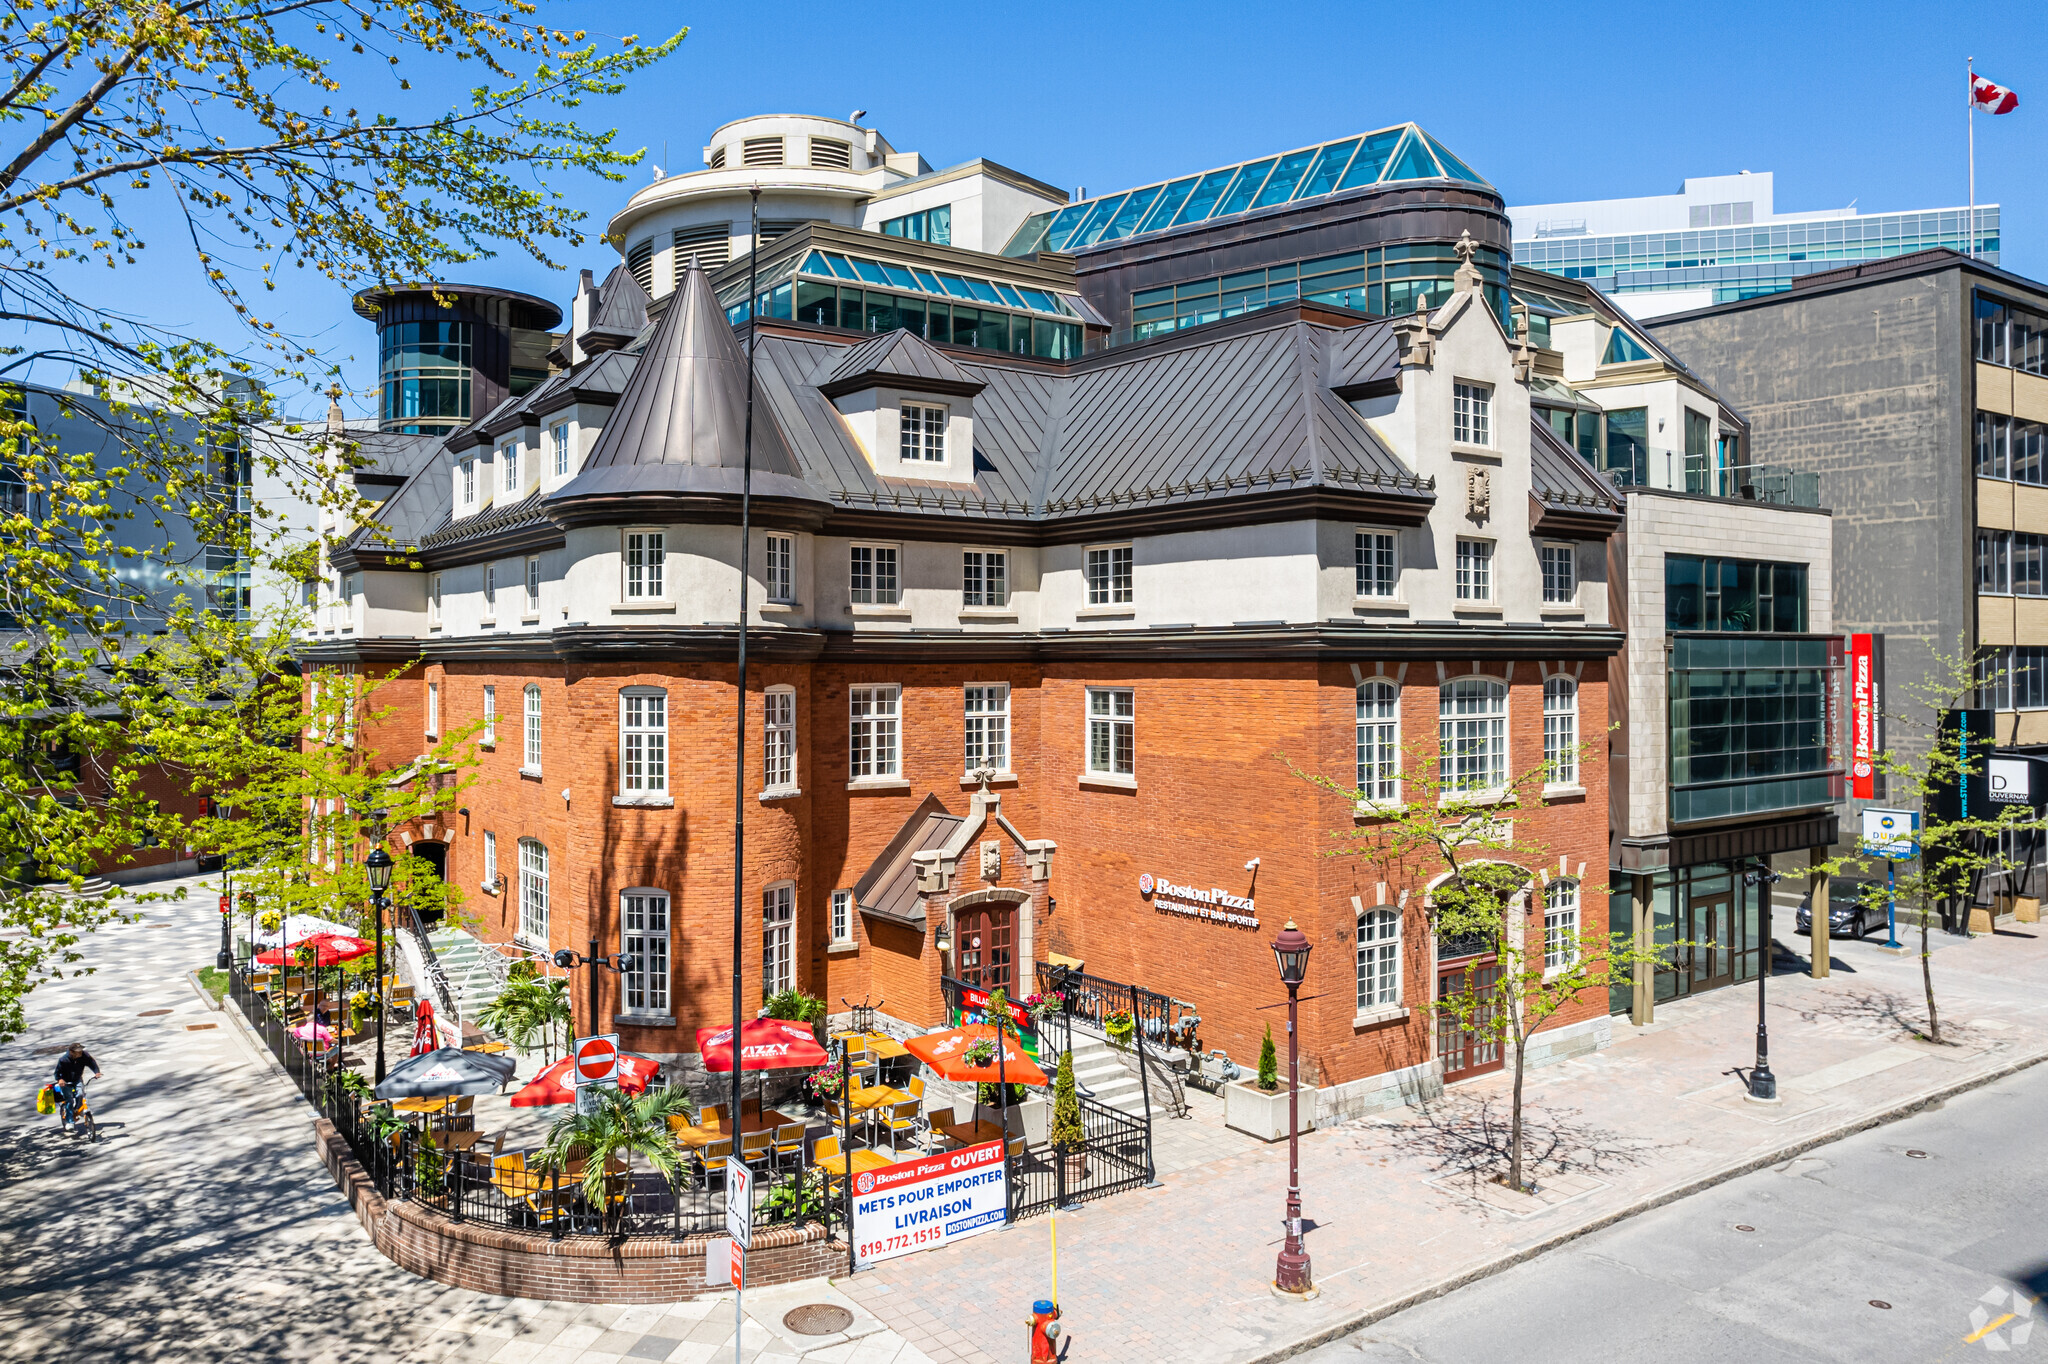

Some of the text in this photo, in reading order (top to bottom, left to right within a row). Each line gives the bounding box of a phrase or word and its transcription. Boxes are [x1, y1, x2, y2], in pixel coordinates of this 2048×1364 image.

[1855, 655, 1869, 699] Pizza
[1855, 700, 1869, 758] Boston
[1989, 792, 2028, 800] DUVERNAY
[1992, 775, 2007, 790] D
[1155, 878, 1211, 903] Boston
[1210, 888, 1255, 911] Pizza
[1154, 899, 1259, 928] RESTAURANT ET BAR SPORTIF
[876, 1168, 915, 1185] Boston
[917, 1163, 946, 1175] Pizza
[950, 1145, 1001, 1168] OUVERT
[859, 1169, 1003, 1215] METS POUR EMPORTER
[895, 1197, 972, 1229] LIVRAISON
[947, 1209, 1005, 1234] BOSTONPIZZA.COM
[860, 1226, 941, 1258] 819.772.1515
